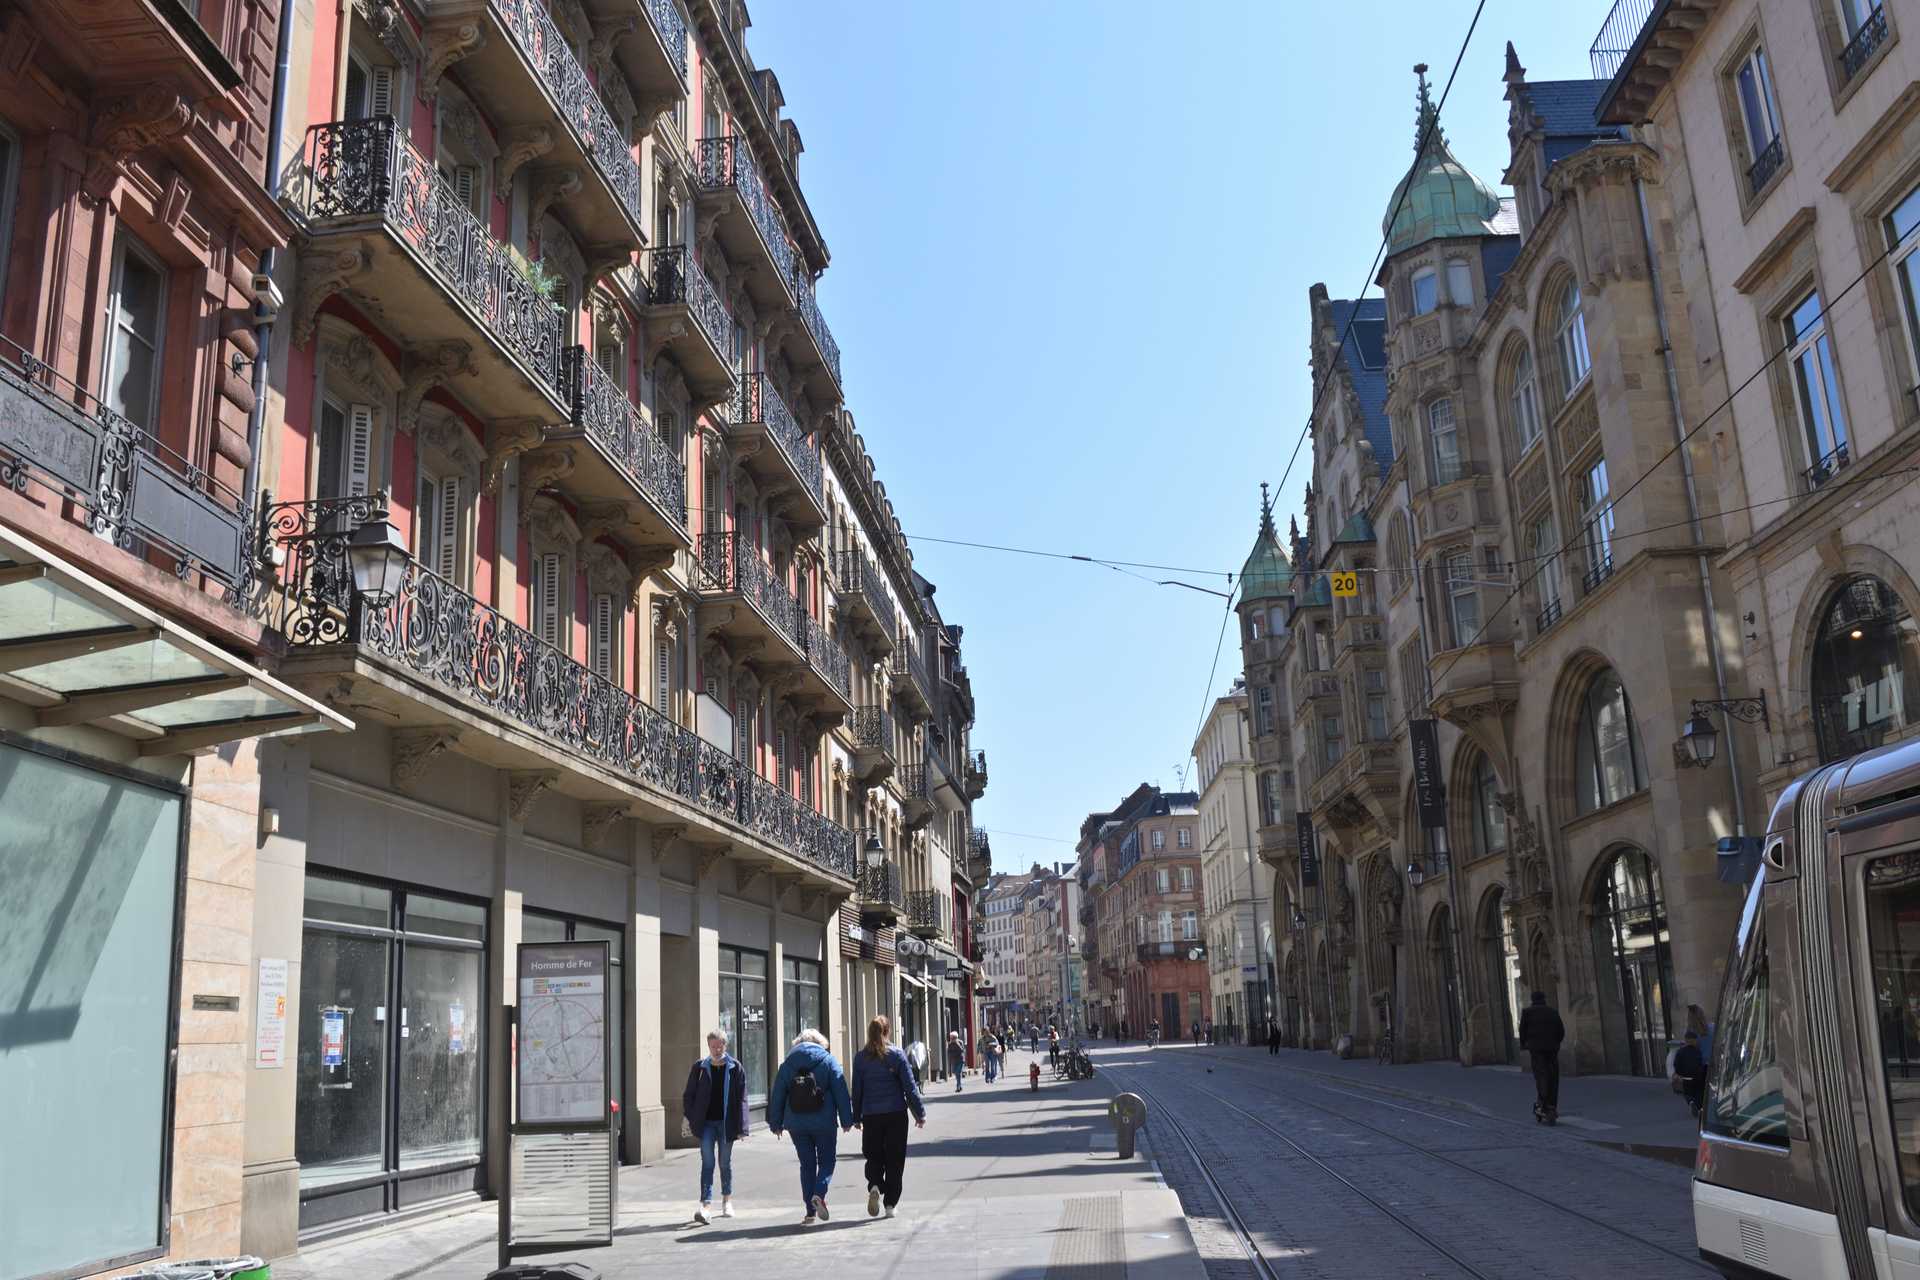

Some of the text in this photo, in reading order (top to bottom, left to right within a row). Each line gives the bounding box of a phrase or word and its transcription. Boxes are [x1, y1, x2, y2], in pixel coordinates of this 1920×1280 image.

[1334, 578, 1354, 591] 20
[531, 960, 592, 970] Homme de Fer
